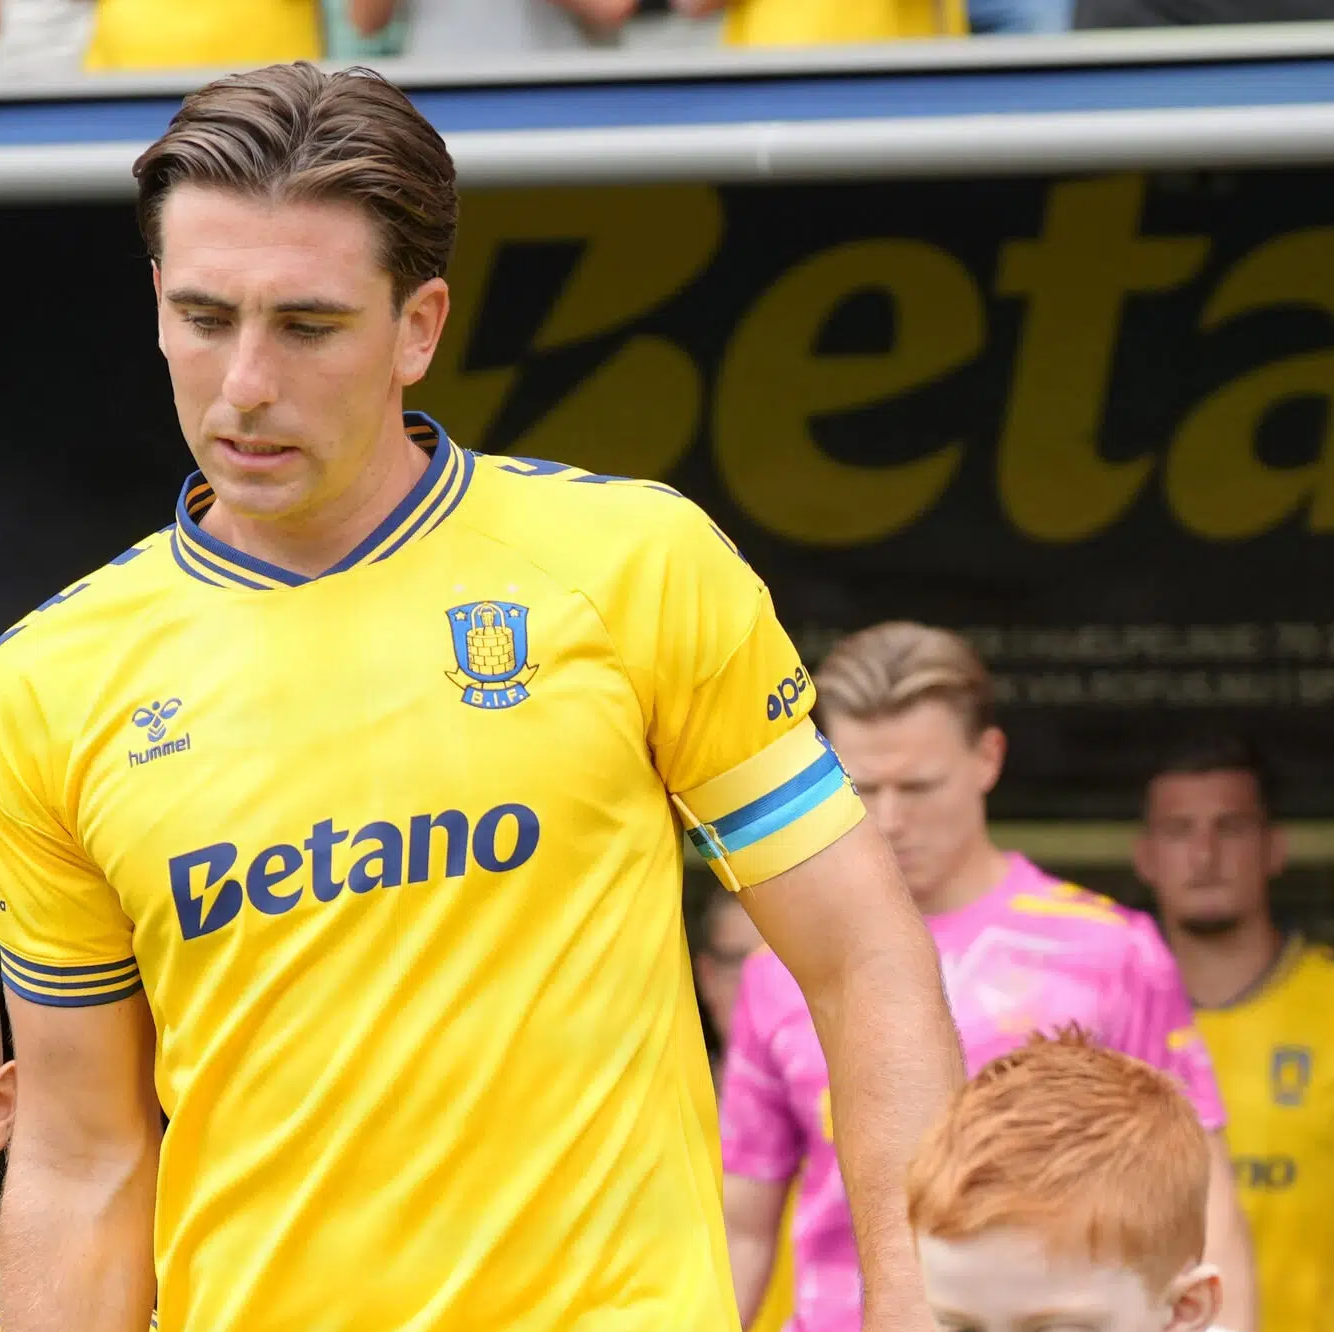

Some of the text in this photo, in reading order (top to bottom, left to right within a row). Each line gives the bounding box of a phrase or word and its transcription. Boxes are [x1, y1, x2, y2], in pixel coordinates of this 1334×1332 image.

[767, 664, 811, 722] ope
[128, 732, 191, 769] hummel
[168, 802, 541, 941] Betano
